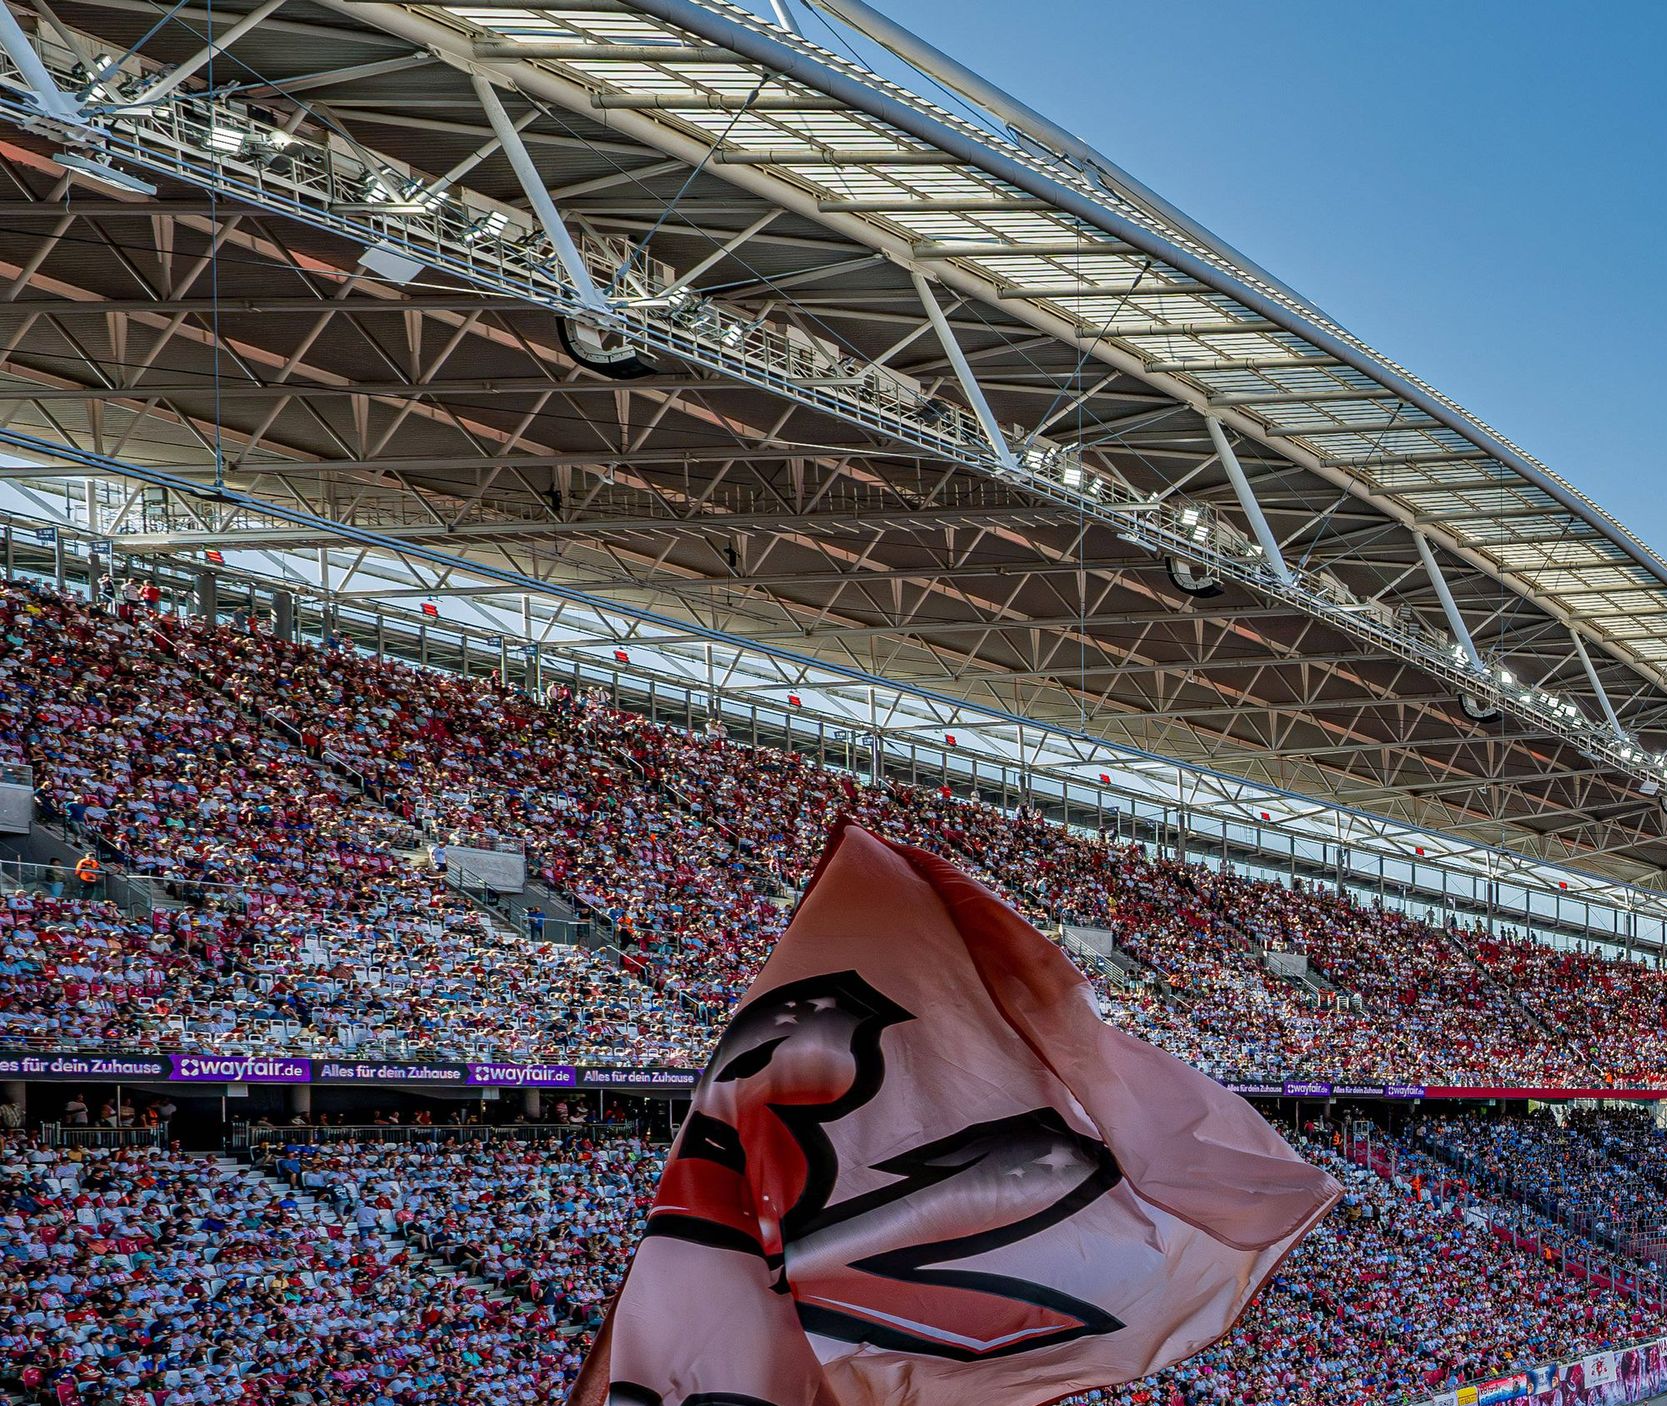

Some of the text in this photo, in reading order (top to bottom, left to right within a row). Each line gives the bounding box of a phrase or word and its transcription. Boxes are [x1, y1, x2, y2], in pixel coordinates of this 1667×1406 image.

[22, 1057, 49, 1073] für
[51, 1058, 88, 1073] dein
[91, 1059, 161, 1075] Zuhause
[200, 1058, 303, 1081] wayfair.de
[322, 1064, 461, 1080] Alles für dein Zuhause
[490, 1064, 570, 1084] wayfair.de
[584, 1070, 694, 1084] Alles für dein Zuhause
